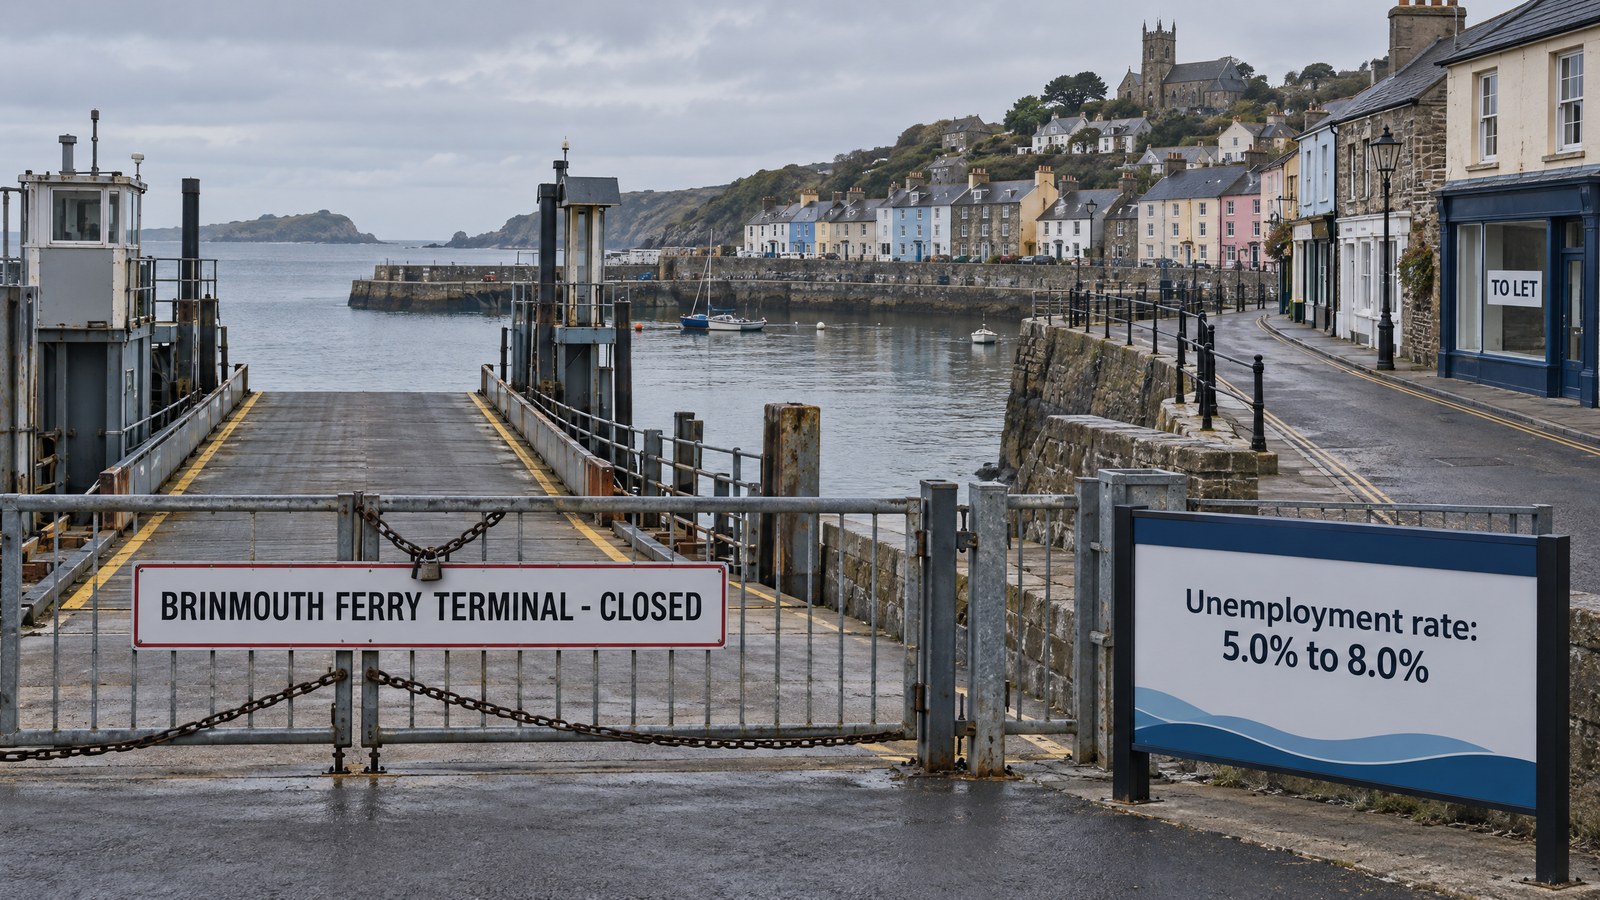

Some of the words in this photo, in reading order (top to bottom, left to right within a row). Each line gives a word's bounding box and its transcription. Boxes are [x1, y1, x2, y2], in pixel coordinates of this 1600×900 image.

[1491, 279, 1510, 296] TO
[1513, 280, 1538, 298] LET
[161, 591, 324, 621] BRINMOUTH
[335, 591, 423, 621] FERRY
[433, 591, 574, 621] TERMINAL
[600, 591, 702, 621] CLOSED
[1186, 588, 1404, 635] Unemployment
[1412, 613, 1477, 642] rate:
[1222, 629, 1299, 668] 5.0%
[1306, 641, 1339, 673] to
[1347, 643, 1429, 684] 8.0%
